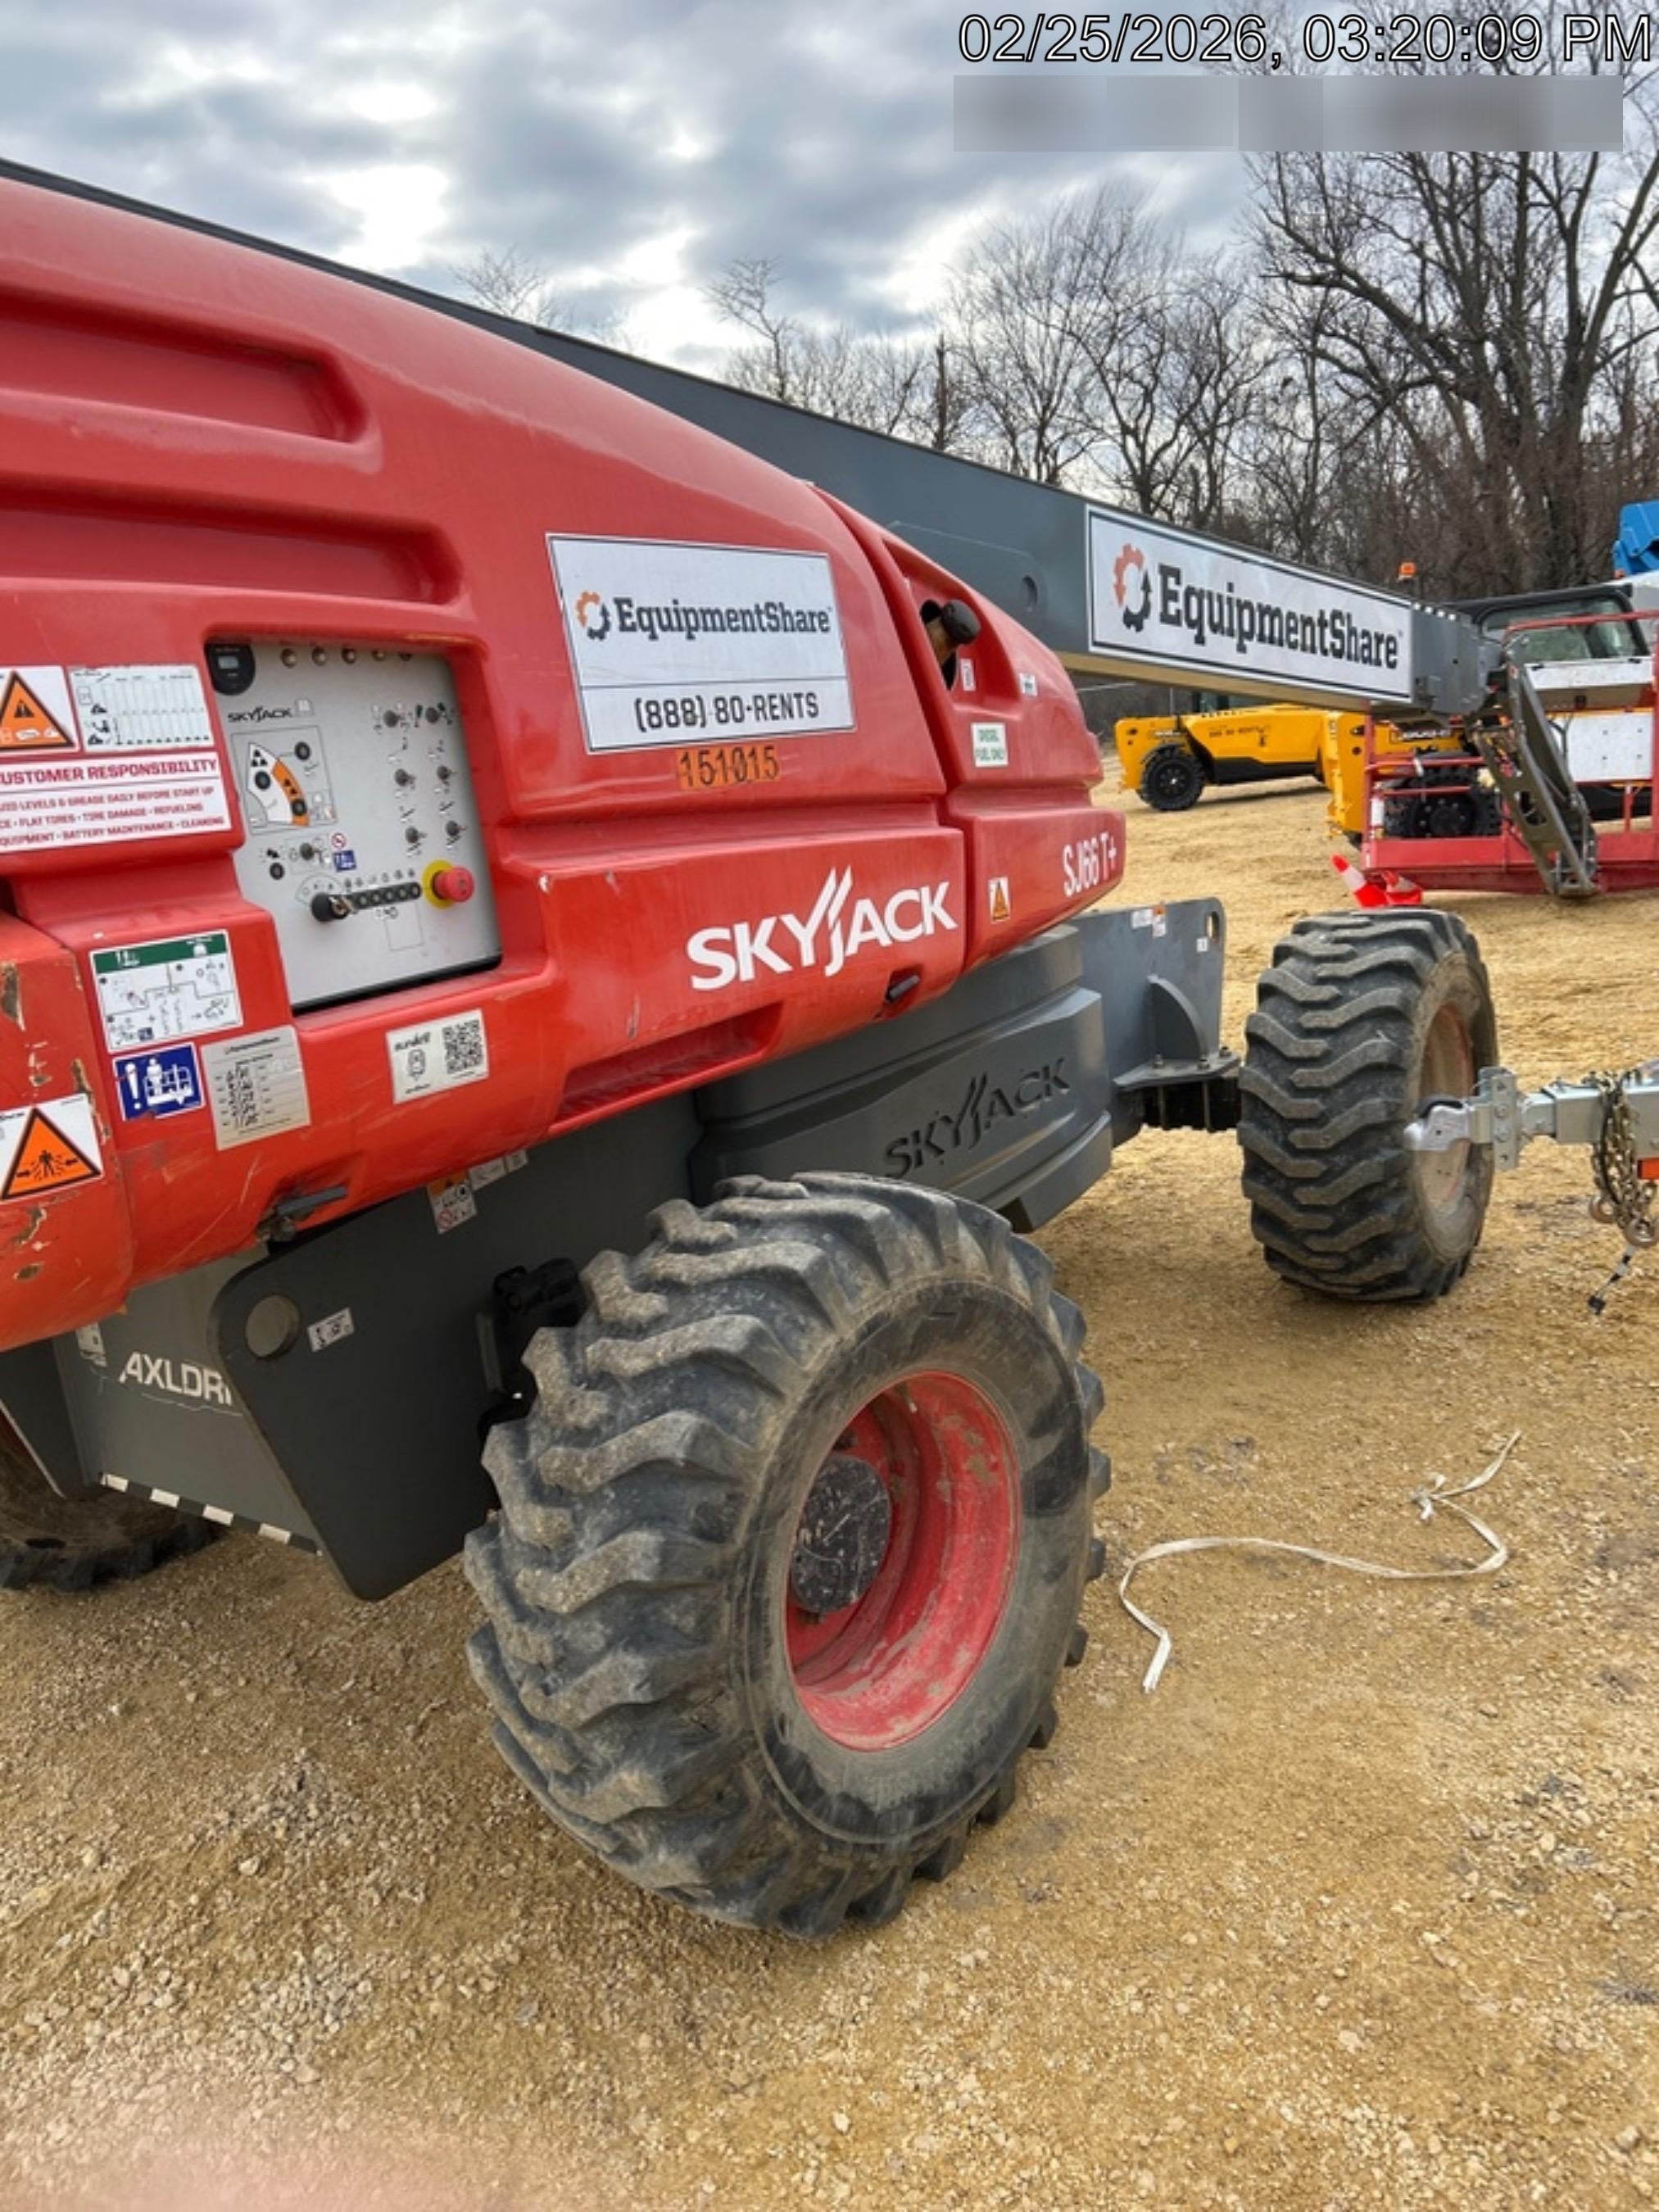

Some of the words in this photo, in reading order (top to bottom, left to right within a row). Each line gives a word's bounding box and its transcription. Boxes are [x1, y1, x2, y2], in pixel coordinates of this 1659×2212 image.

[613, 596, 832, 641] EquipmentShare
[1158, 563, 1398, 670] EquipmentShare
[634, 695, 706, 732] (888)
[0, 765, 84, 786] USTOMER
[87, 759, 217, 780] RESPONSIBILITY
[680, 745, 779, 787] 151015
[1062, 836, 1100, 898] SJ66
[686, 864, 958, 990] SKYJACK
[884, 1055, 1071, 1180] SKYJACK
